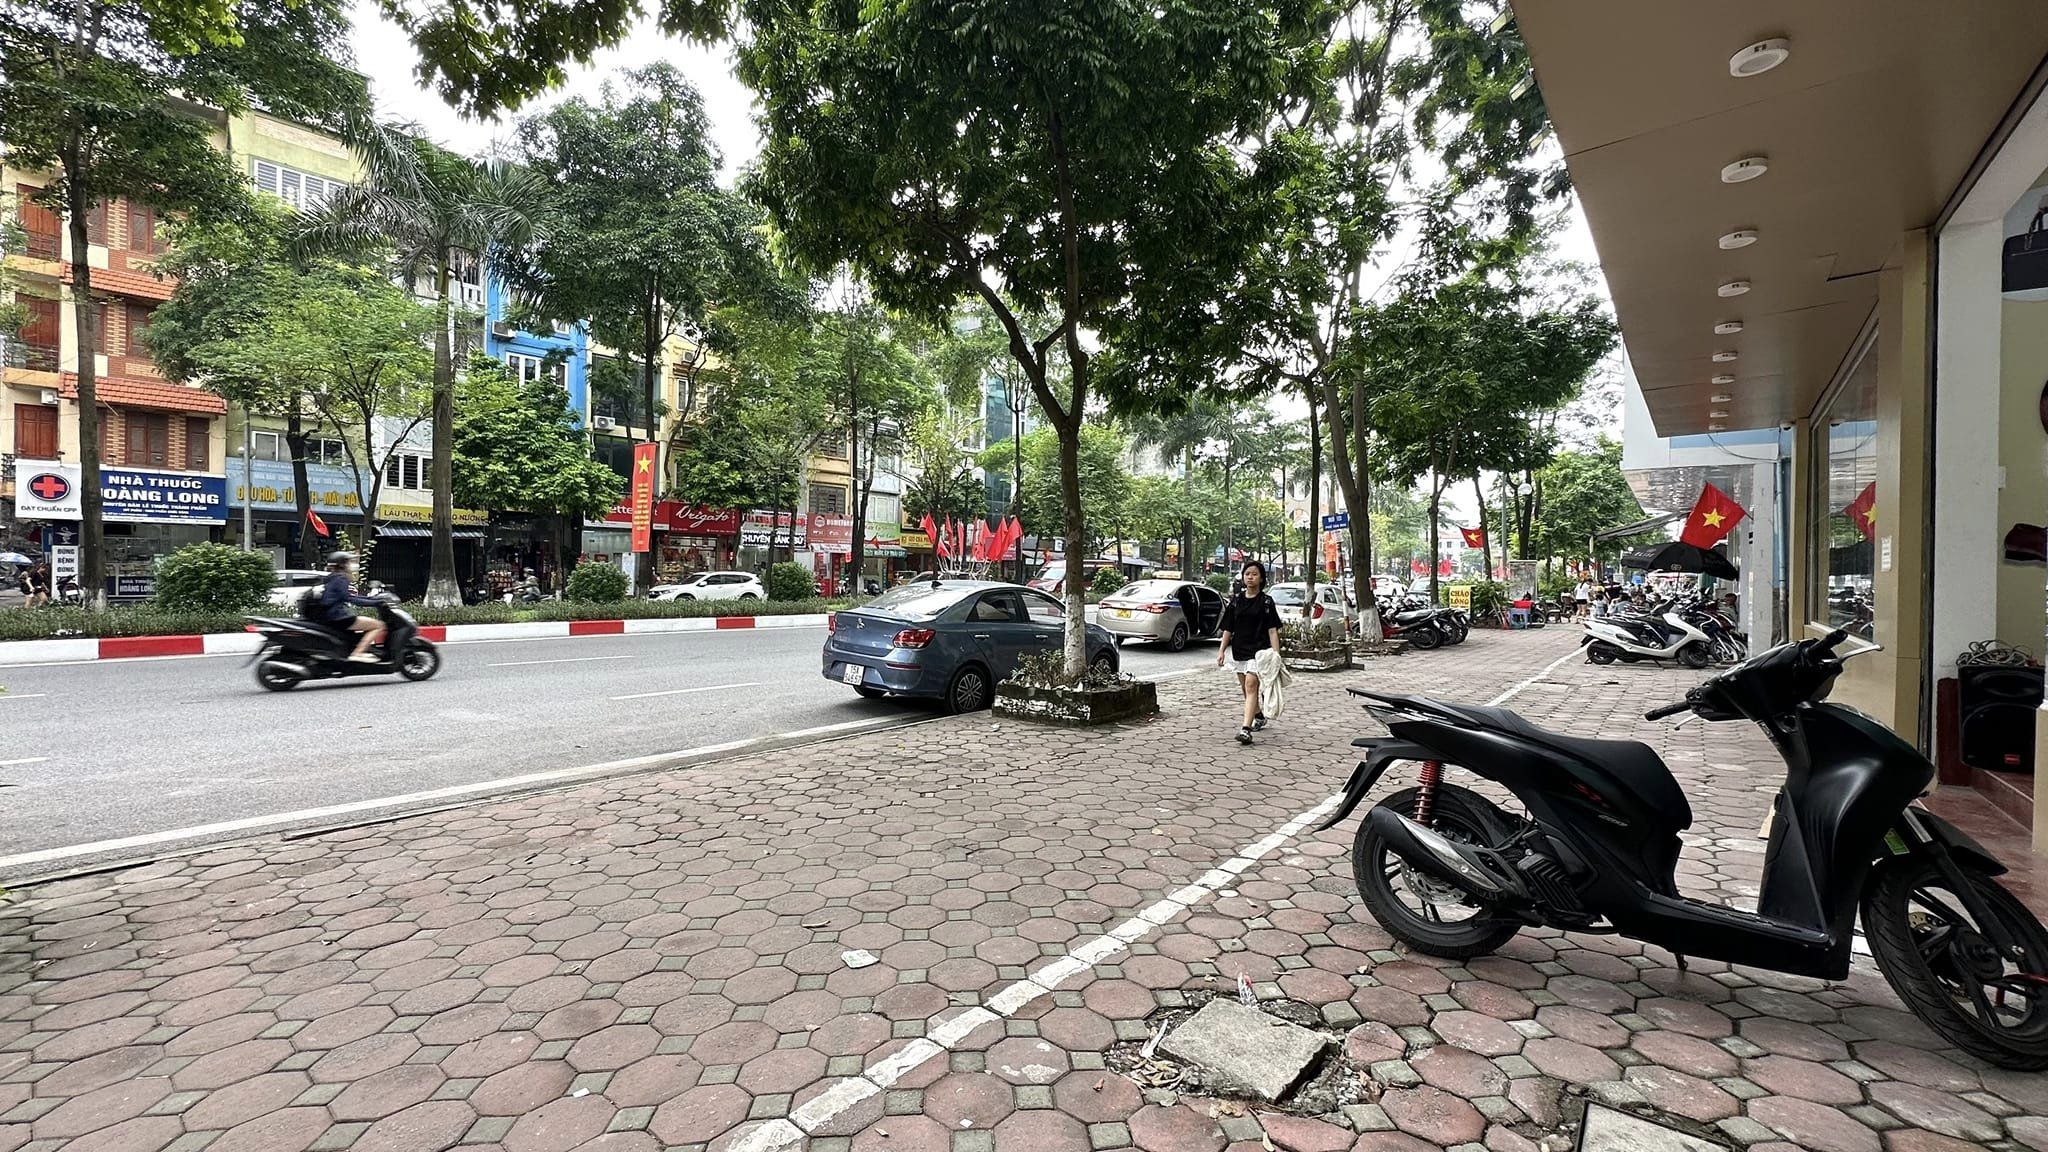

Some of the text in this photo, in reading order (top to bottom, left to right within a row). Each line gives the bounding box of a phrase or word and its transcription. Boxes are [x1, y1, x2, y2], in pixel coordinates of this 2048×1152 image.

[108, 474, 202, 489] NHÀ THUỐC
[167, 491, 219, 505] LONG
